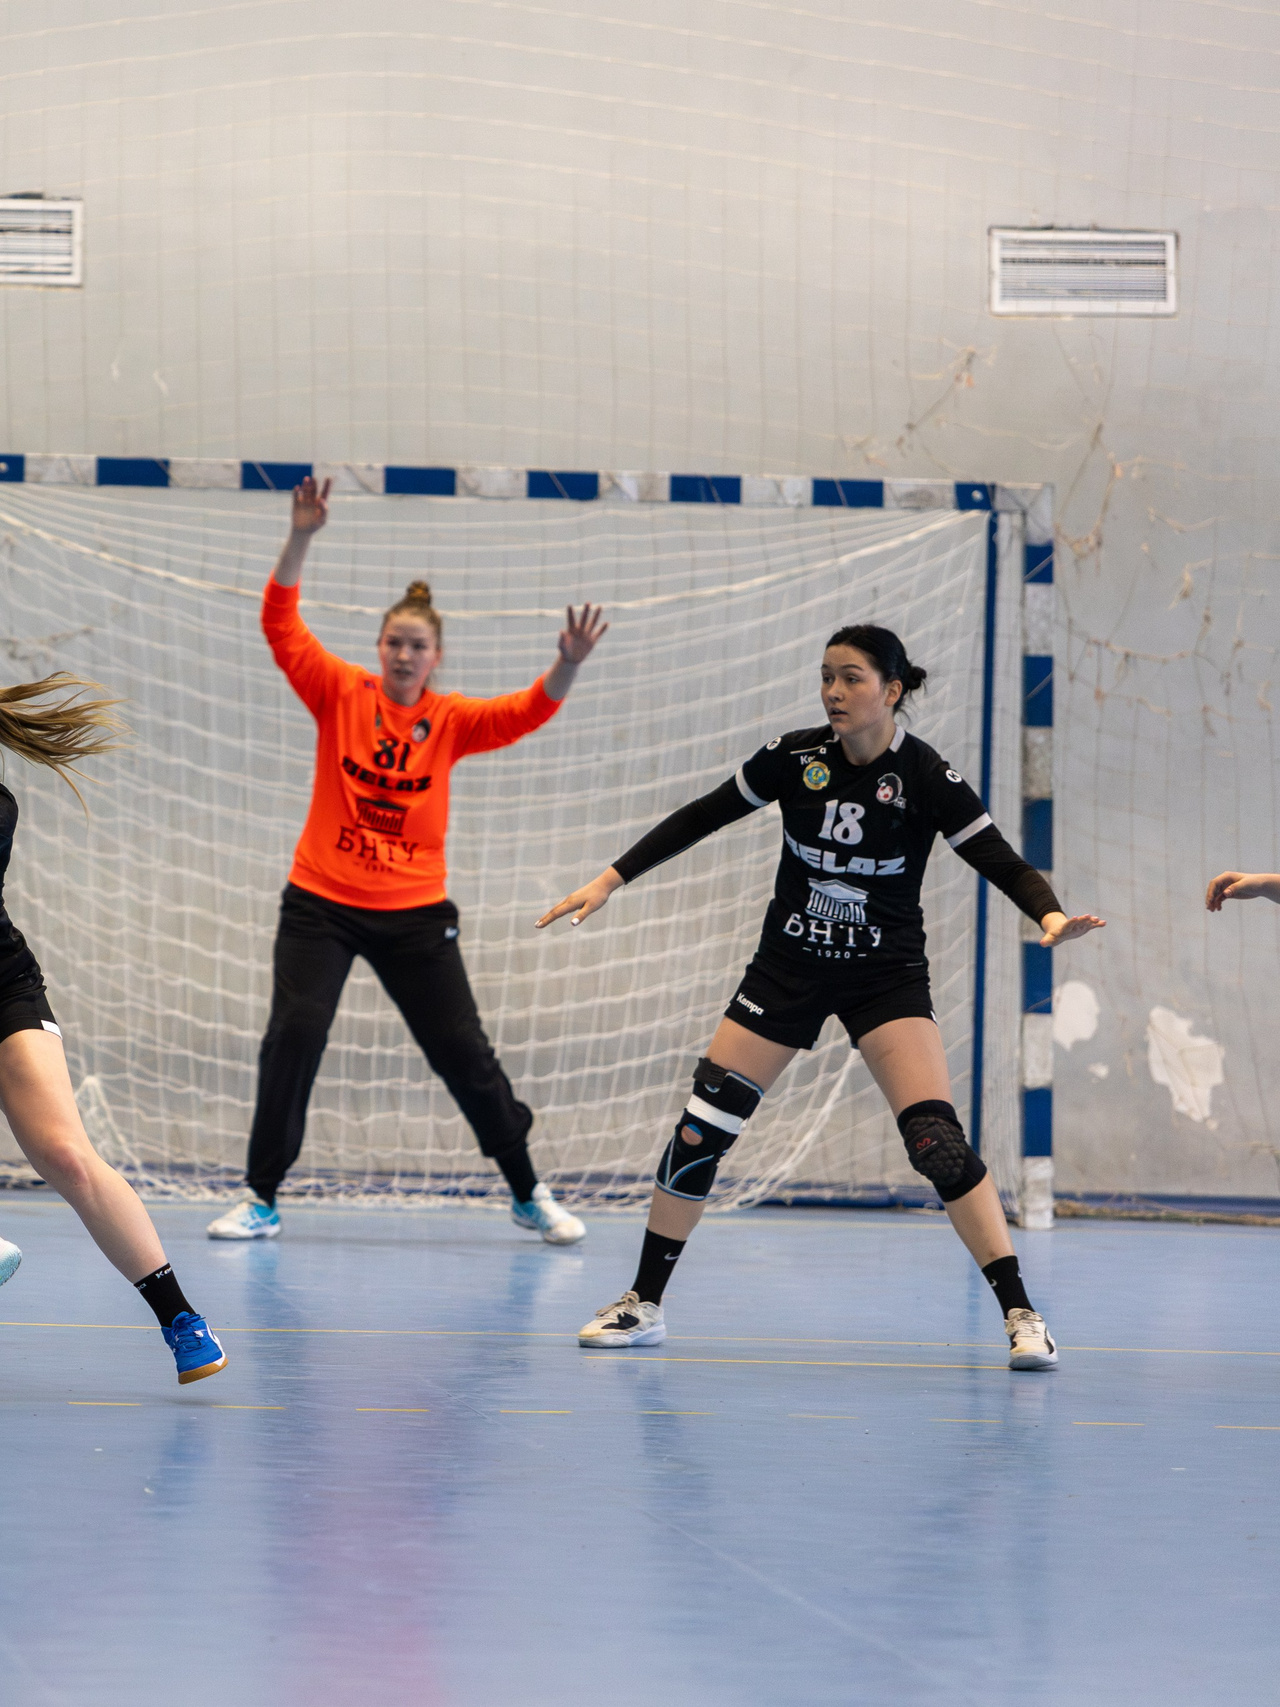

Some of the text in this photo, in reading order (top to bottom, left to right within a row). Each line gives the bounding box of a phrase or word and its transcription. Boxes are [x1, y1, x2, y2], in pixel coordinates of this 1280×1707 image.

[374, 738, 410, 772] 81
[342, 756, 432, 792] BELAZ
[818, 799, 866, 845] 18
[335, 825, 419, 862] БНТУ
[783, 912, 883, 947] БНТУ
[736, 992, 765, 1016] Kempa
